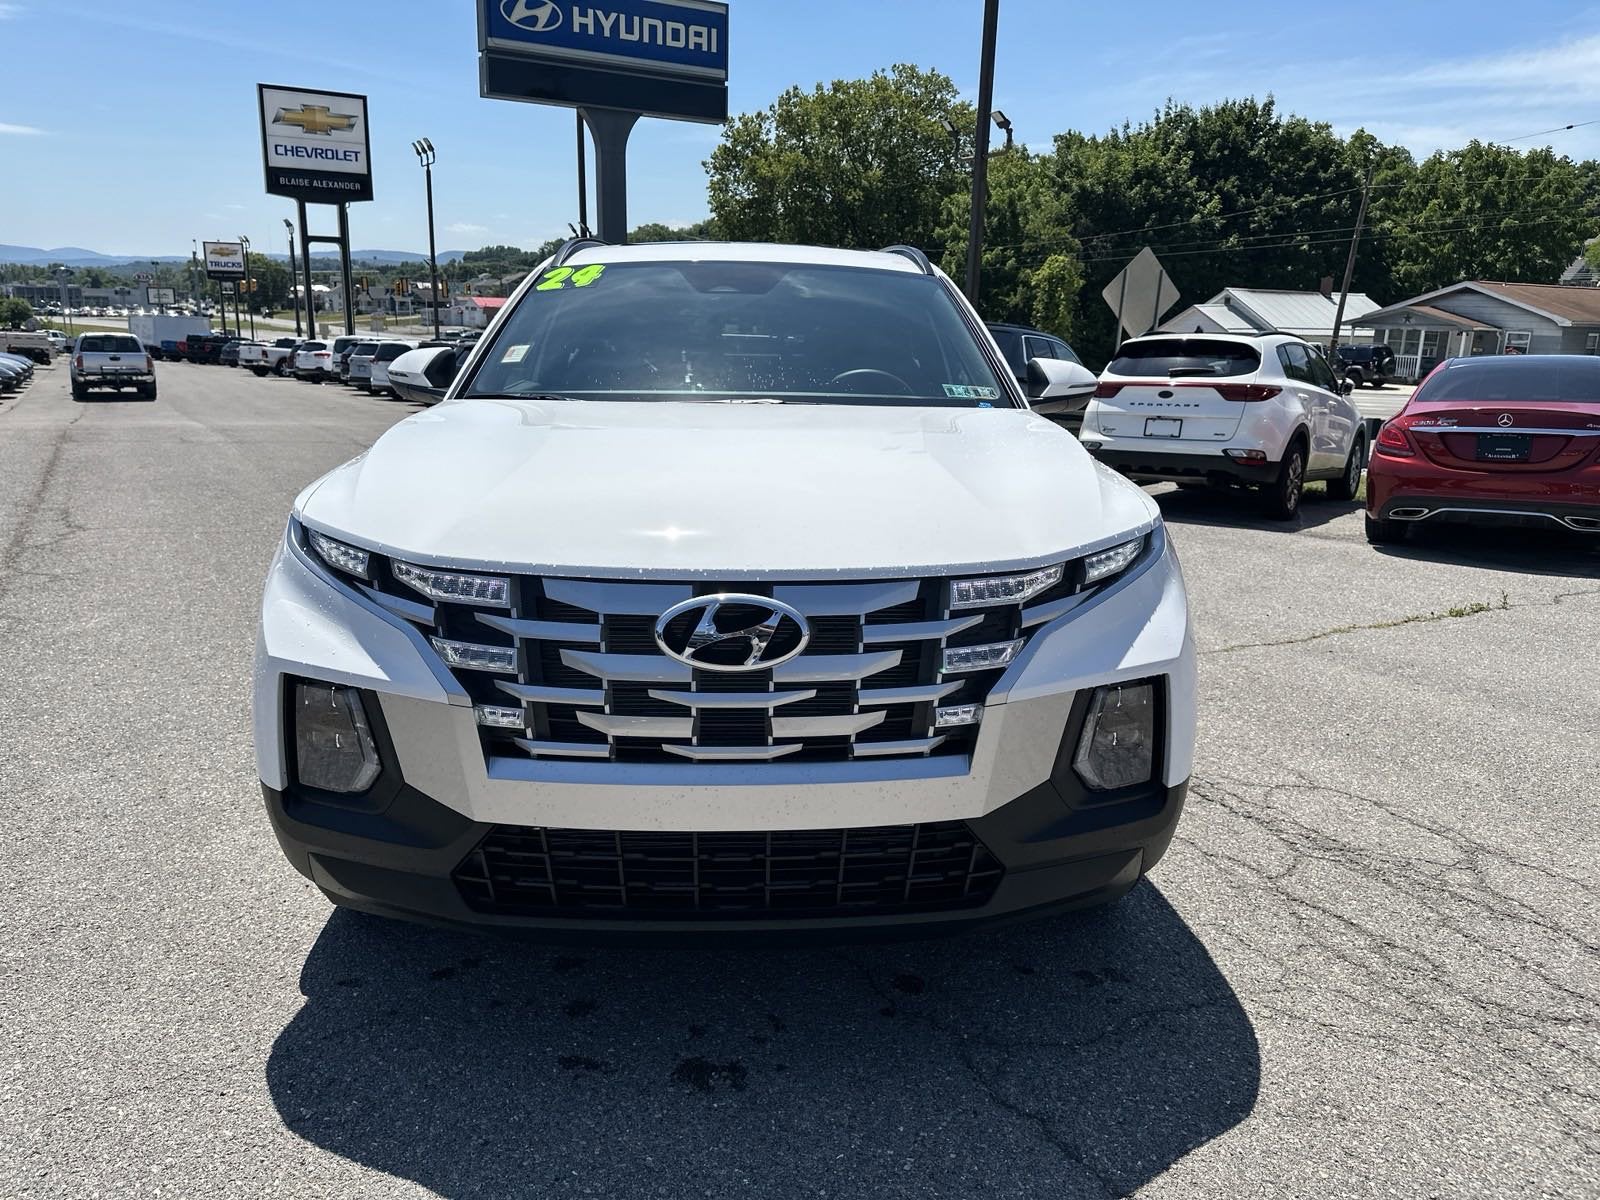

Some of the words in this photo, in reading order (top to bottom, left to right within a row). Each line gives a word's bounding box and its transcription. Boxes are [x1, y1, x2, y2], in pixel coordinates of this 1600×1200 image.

[572, 6, 717, 53] HYUNDAI
[274, 144, 361, 162] CHEVROLET
[279, 177, 310, 187] BLAISE
[312, 179, 361, 190] ALEXANDER
[209, 260, 243, 268] TRUCKS
[536, 264, 606, 291] 24
